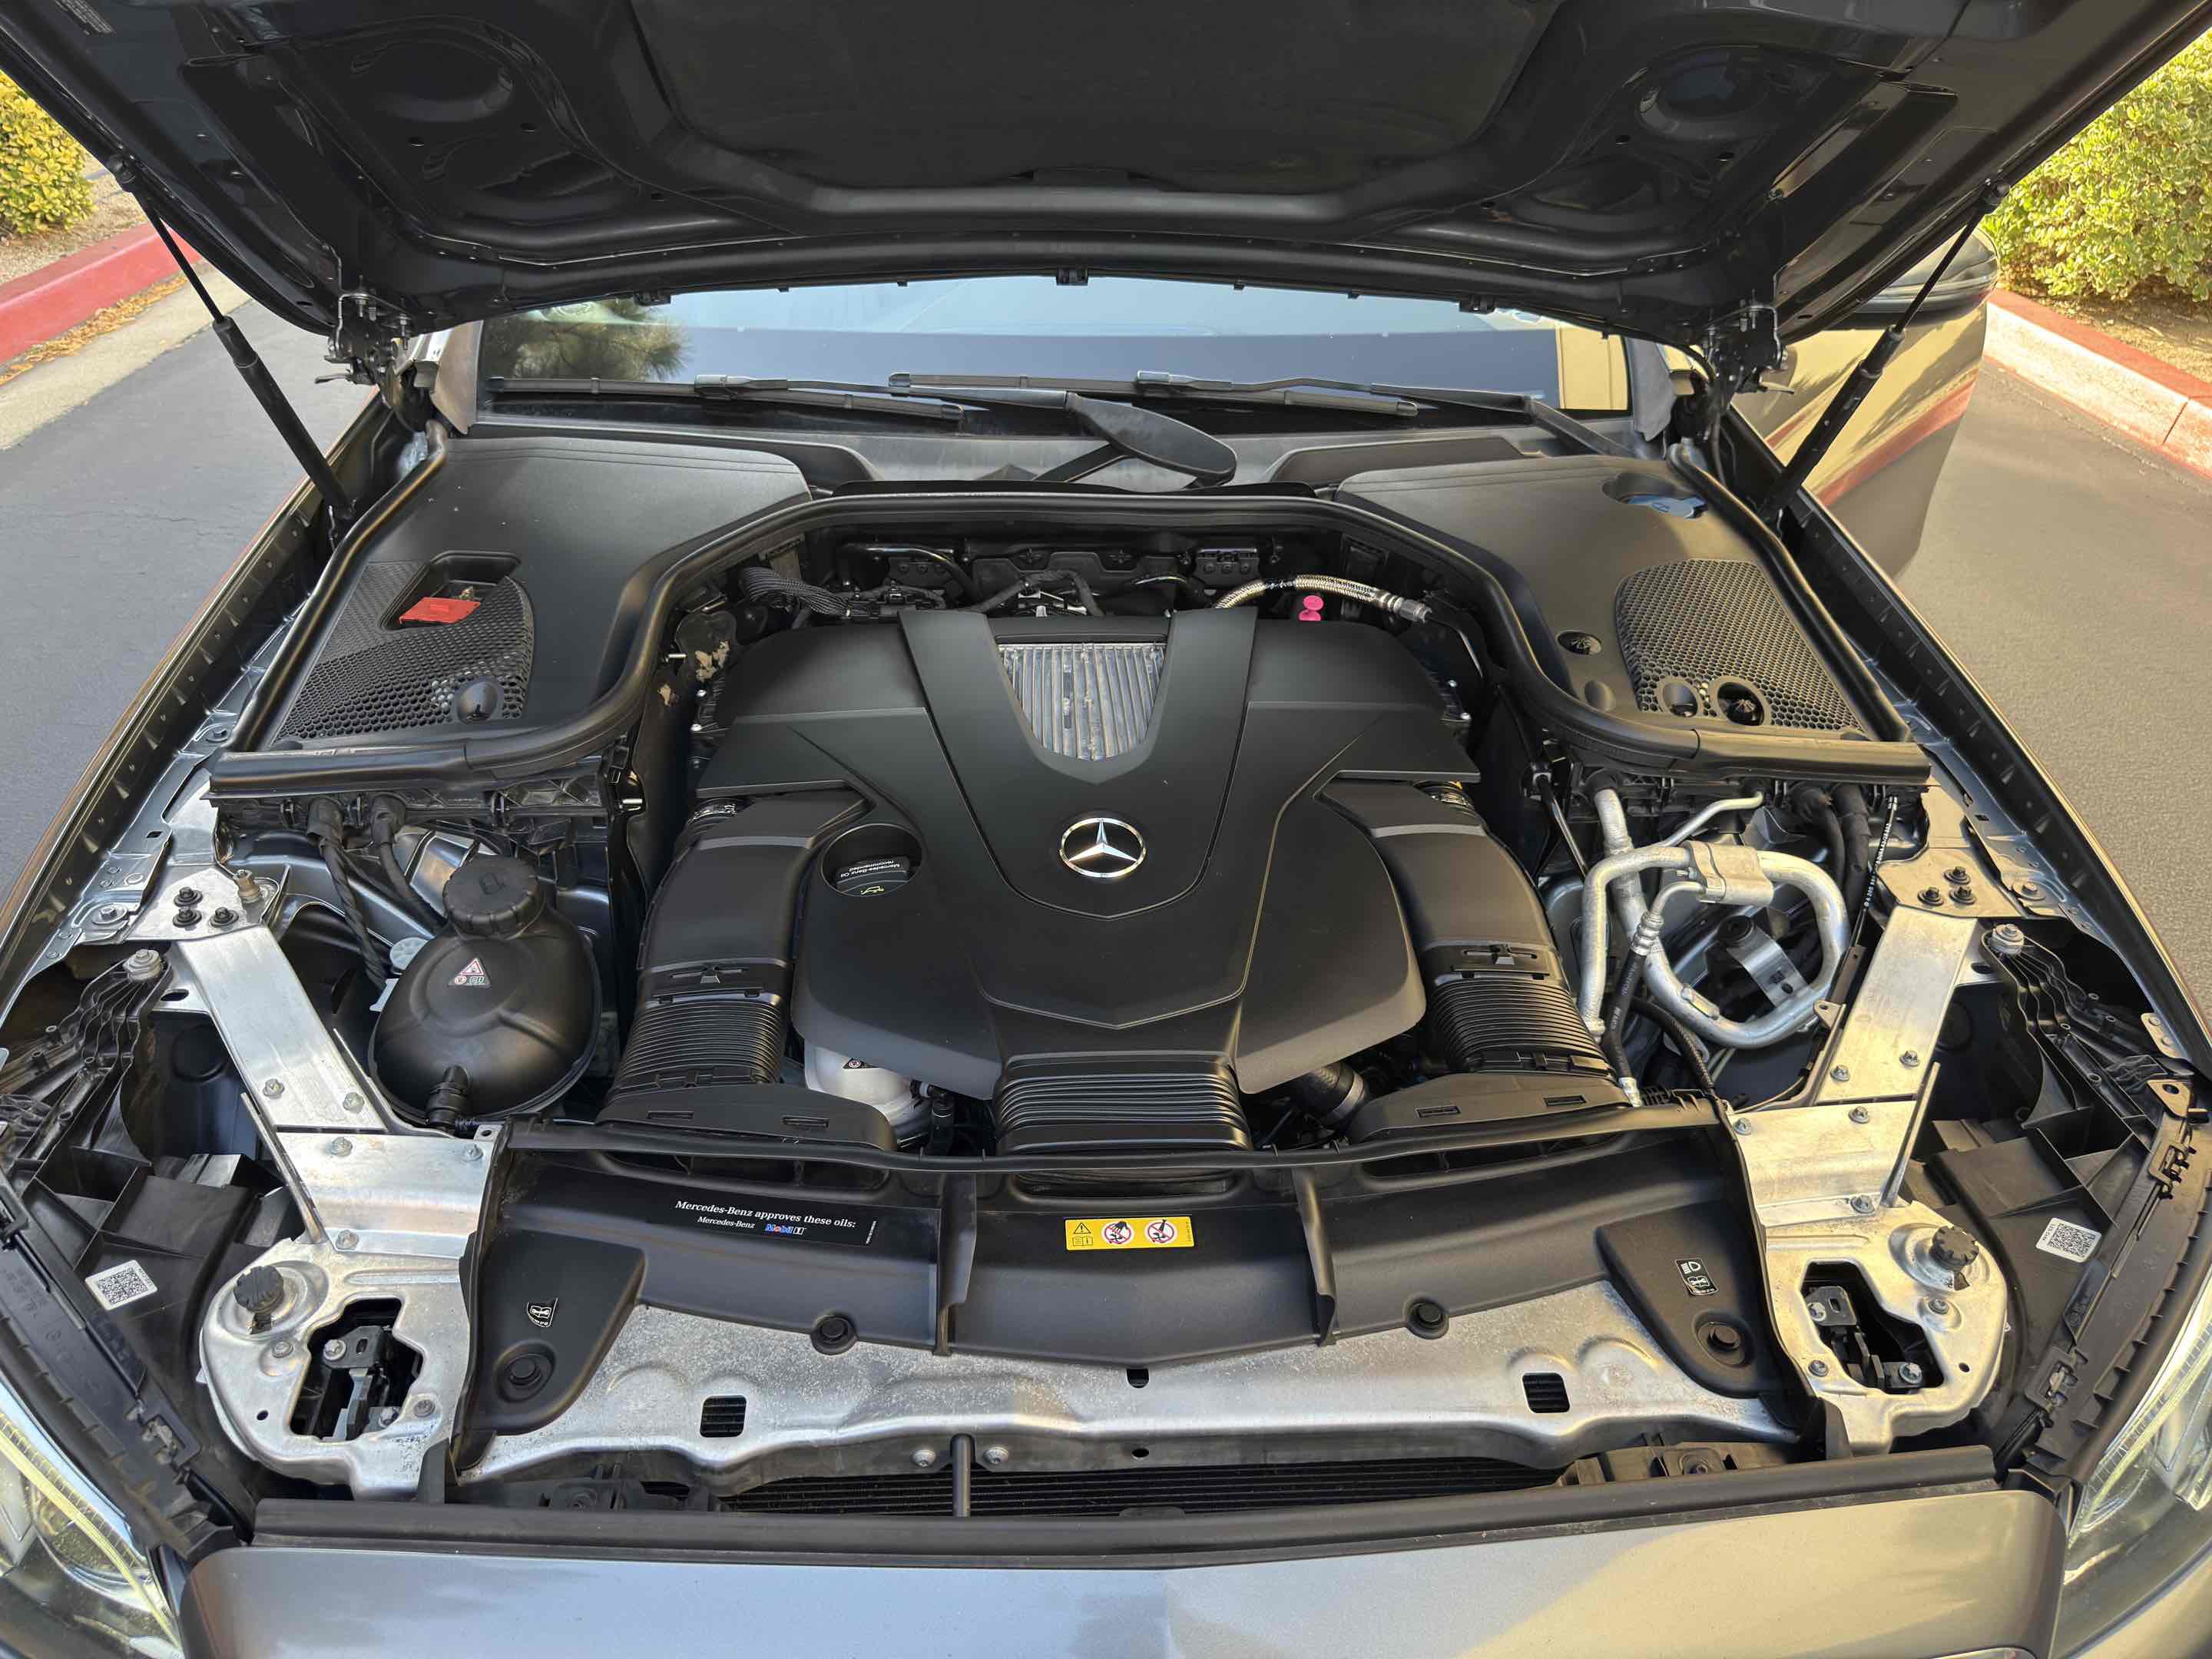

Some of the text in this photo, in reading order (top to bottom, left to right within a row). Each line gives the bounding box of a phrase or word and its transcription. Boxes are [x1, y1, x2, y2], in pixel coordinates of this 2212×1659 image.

[849, 859, 894, 873] recommended
[851, 863, 900, 876] Mercedes-Benz
[675, 1200, 856, 1228] Mercedes-Benz approves these oils:
[697, 1216, 756, 1229] Mercedes-Benz
[765, 1224, 793, 1234] Mobil
